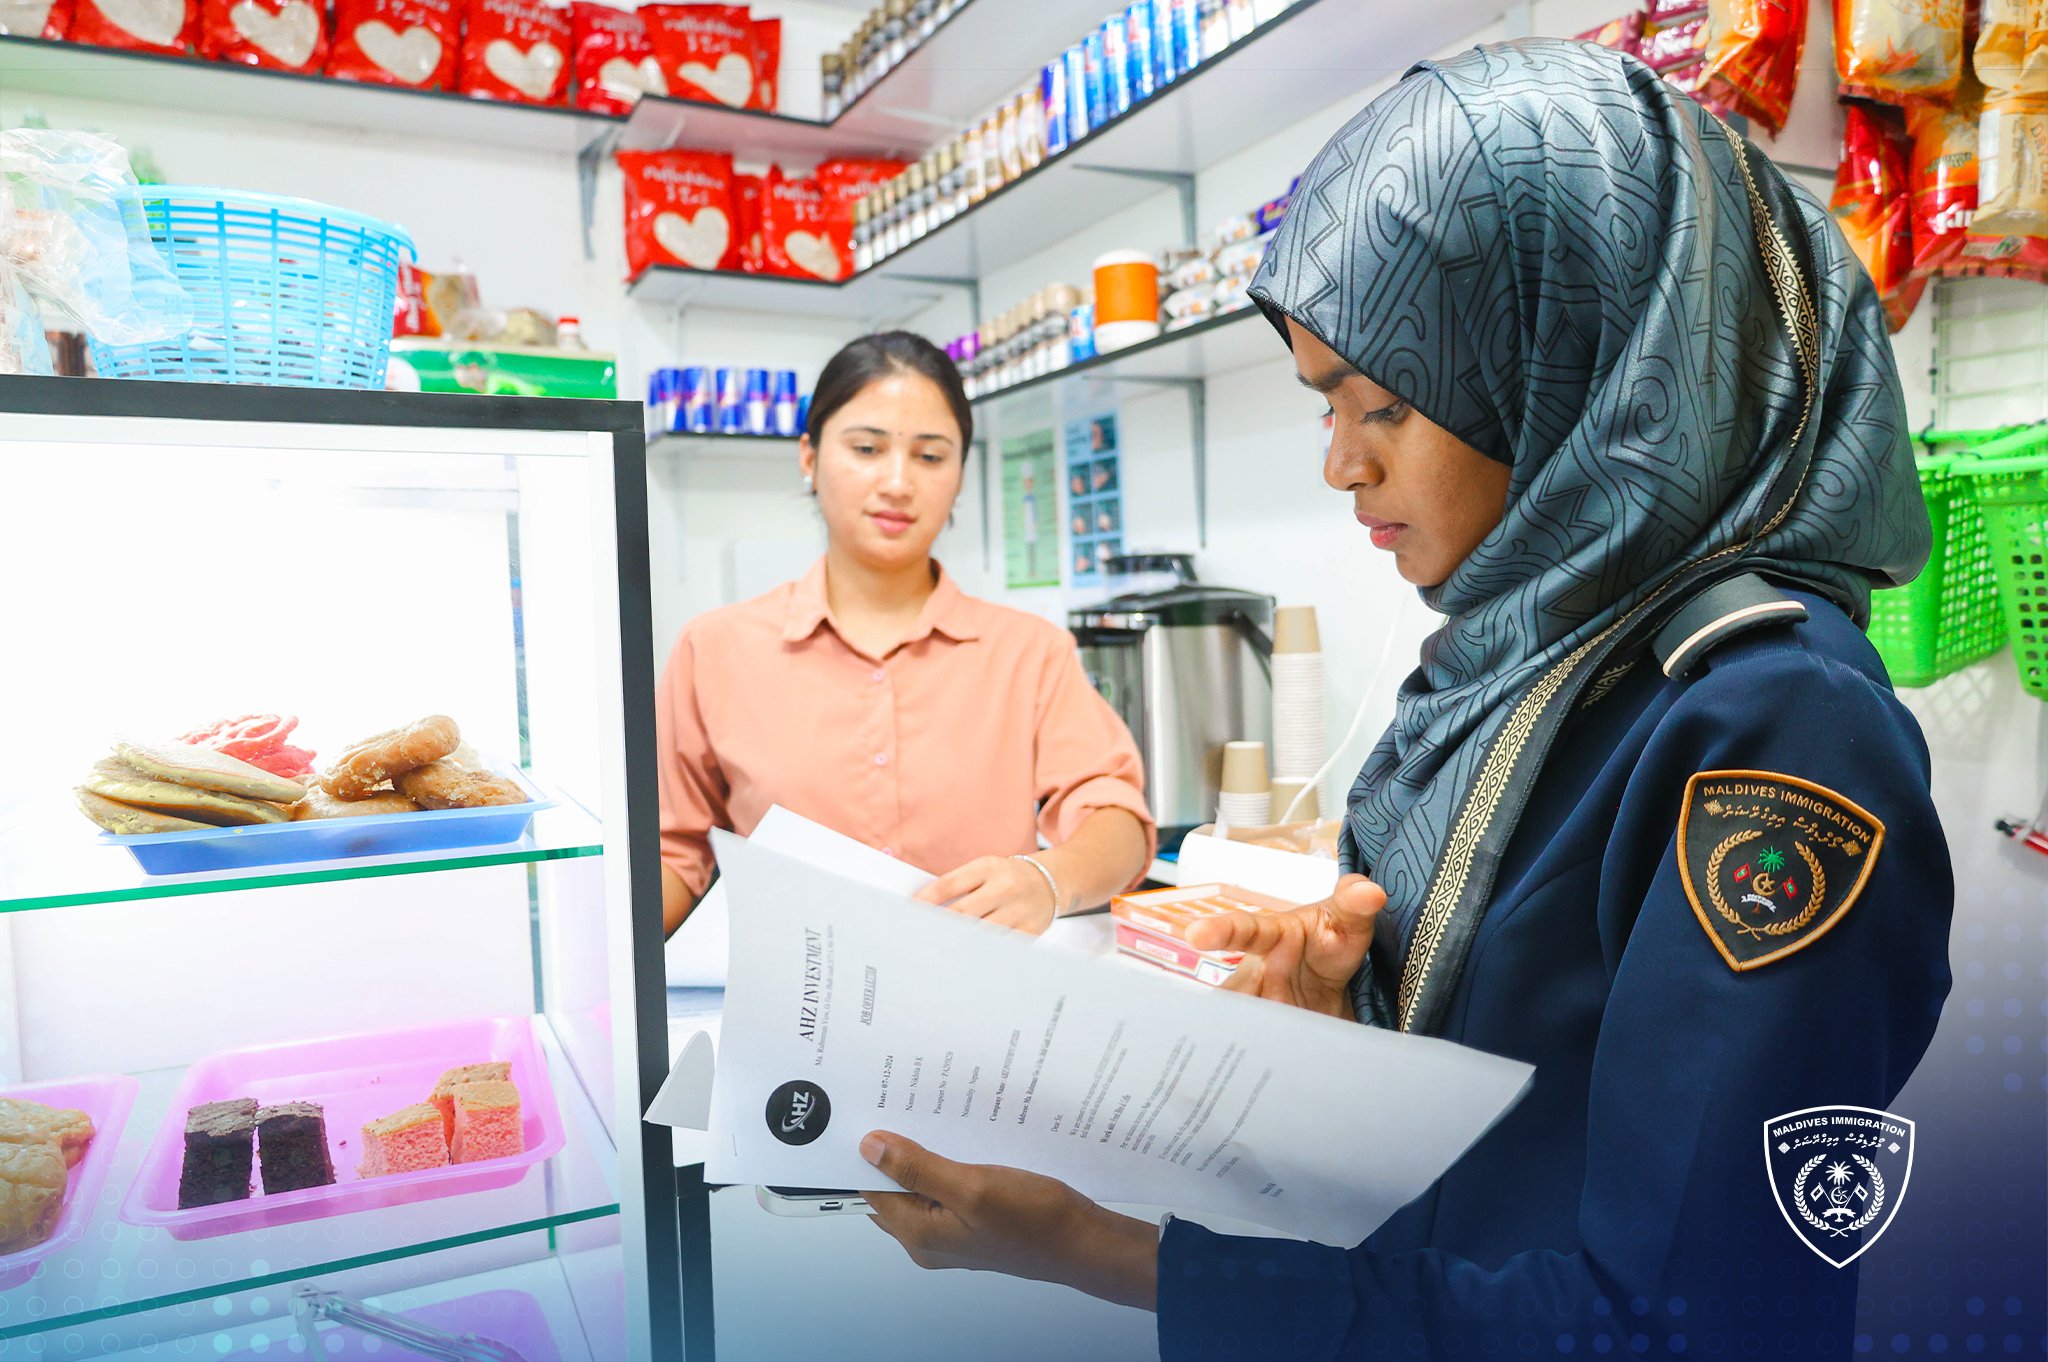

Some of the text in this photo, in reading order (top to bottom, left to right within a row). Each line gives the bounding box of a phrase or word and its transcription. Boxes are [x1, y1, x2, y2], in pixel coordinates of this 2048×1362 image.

[1703, 784, 1871, 843] MALDIVES IMMIGRATION
[799, 927, 823, 1042] AHZ INVESTMENT
[860, 965, 878, 1026] JOB OFFER LETTER
[878, 1055, 893, 1109] Date: 07-12-2024
[905, 1091, 916, 1111] Name
[933, 1089, 946, 1115] Passport
[790, 1090, 811, 1130] AHZ
[989, 1095, 1002, 1122] Company
